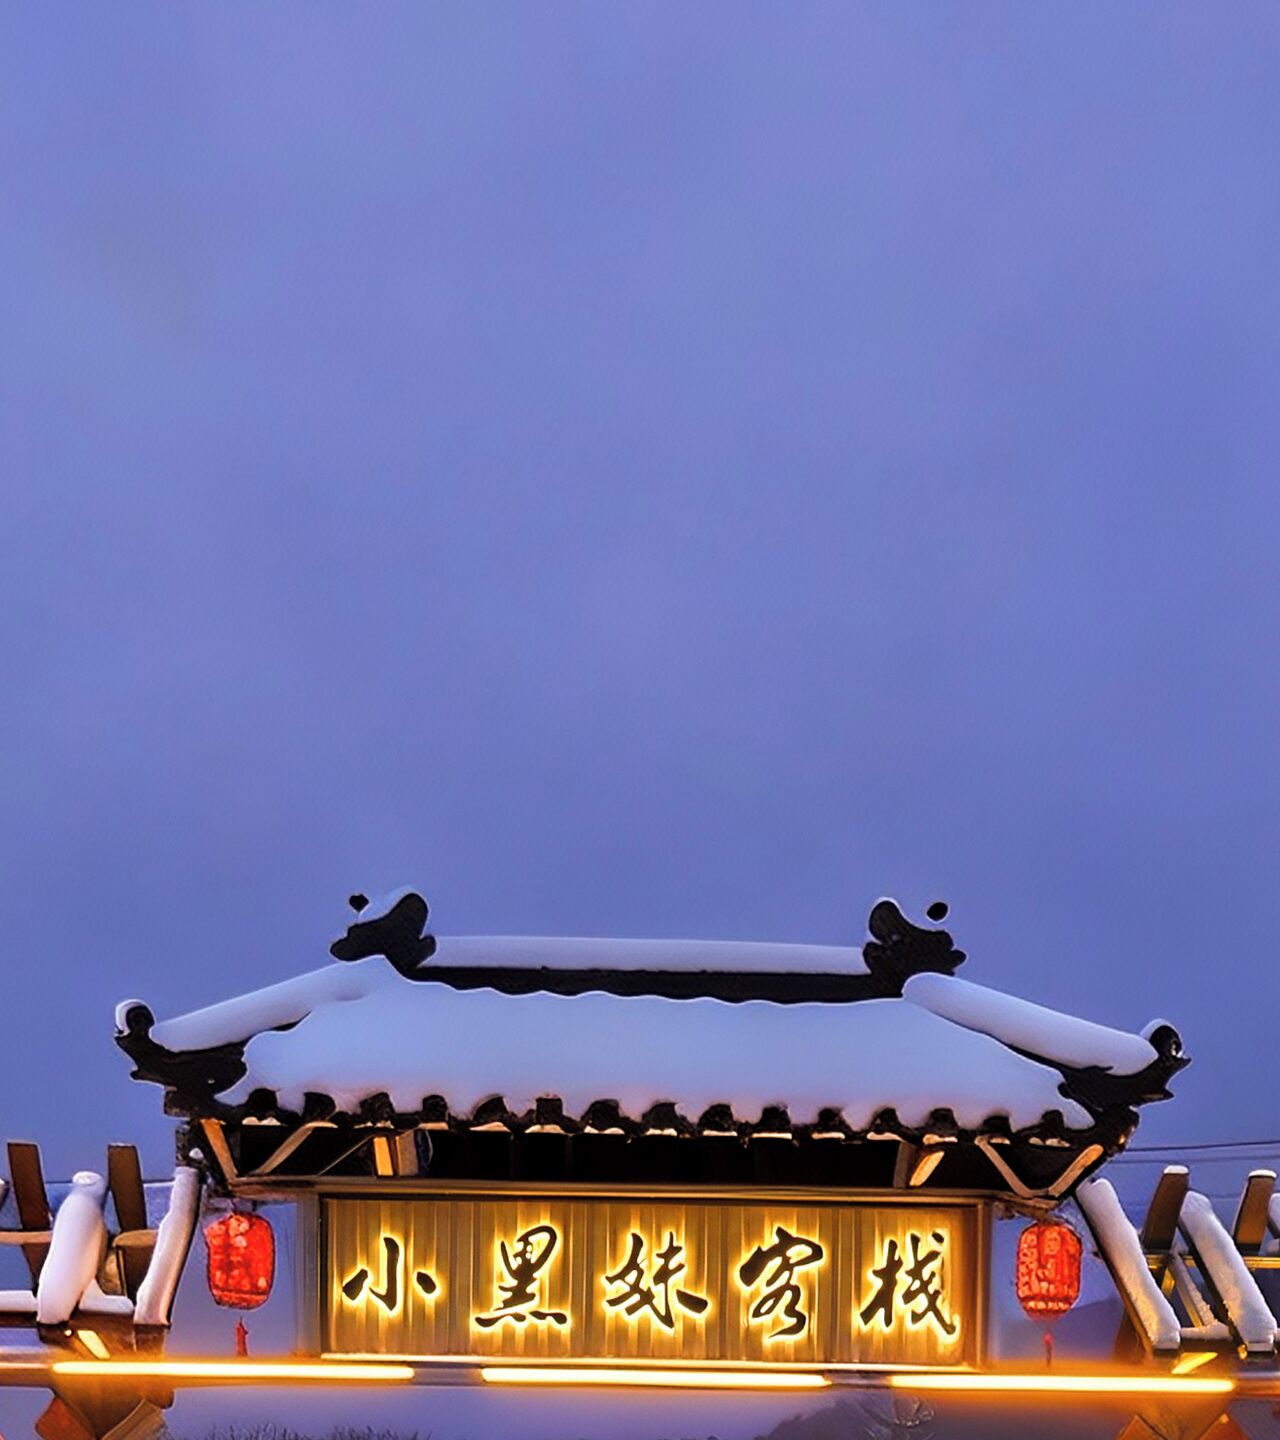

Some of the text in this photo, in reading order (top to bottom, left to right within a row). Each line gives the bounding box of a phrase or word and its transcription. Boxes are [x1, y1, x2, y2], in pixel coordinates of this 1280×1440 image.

[342, 1225, 957, 1339] 小黑妹客栈
